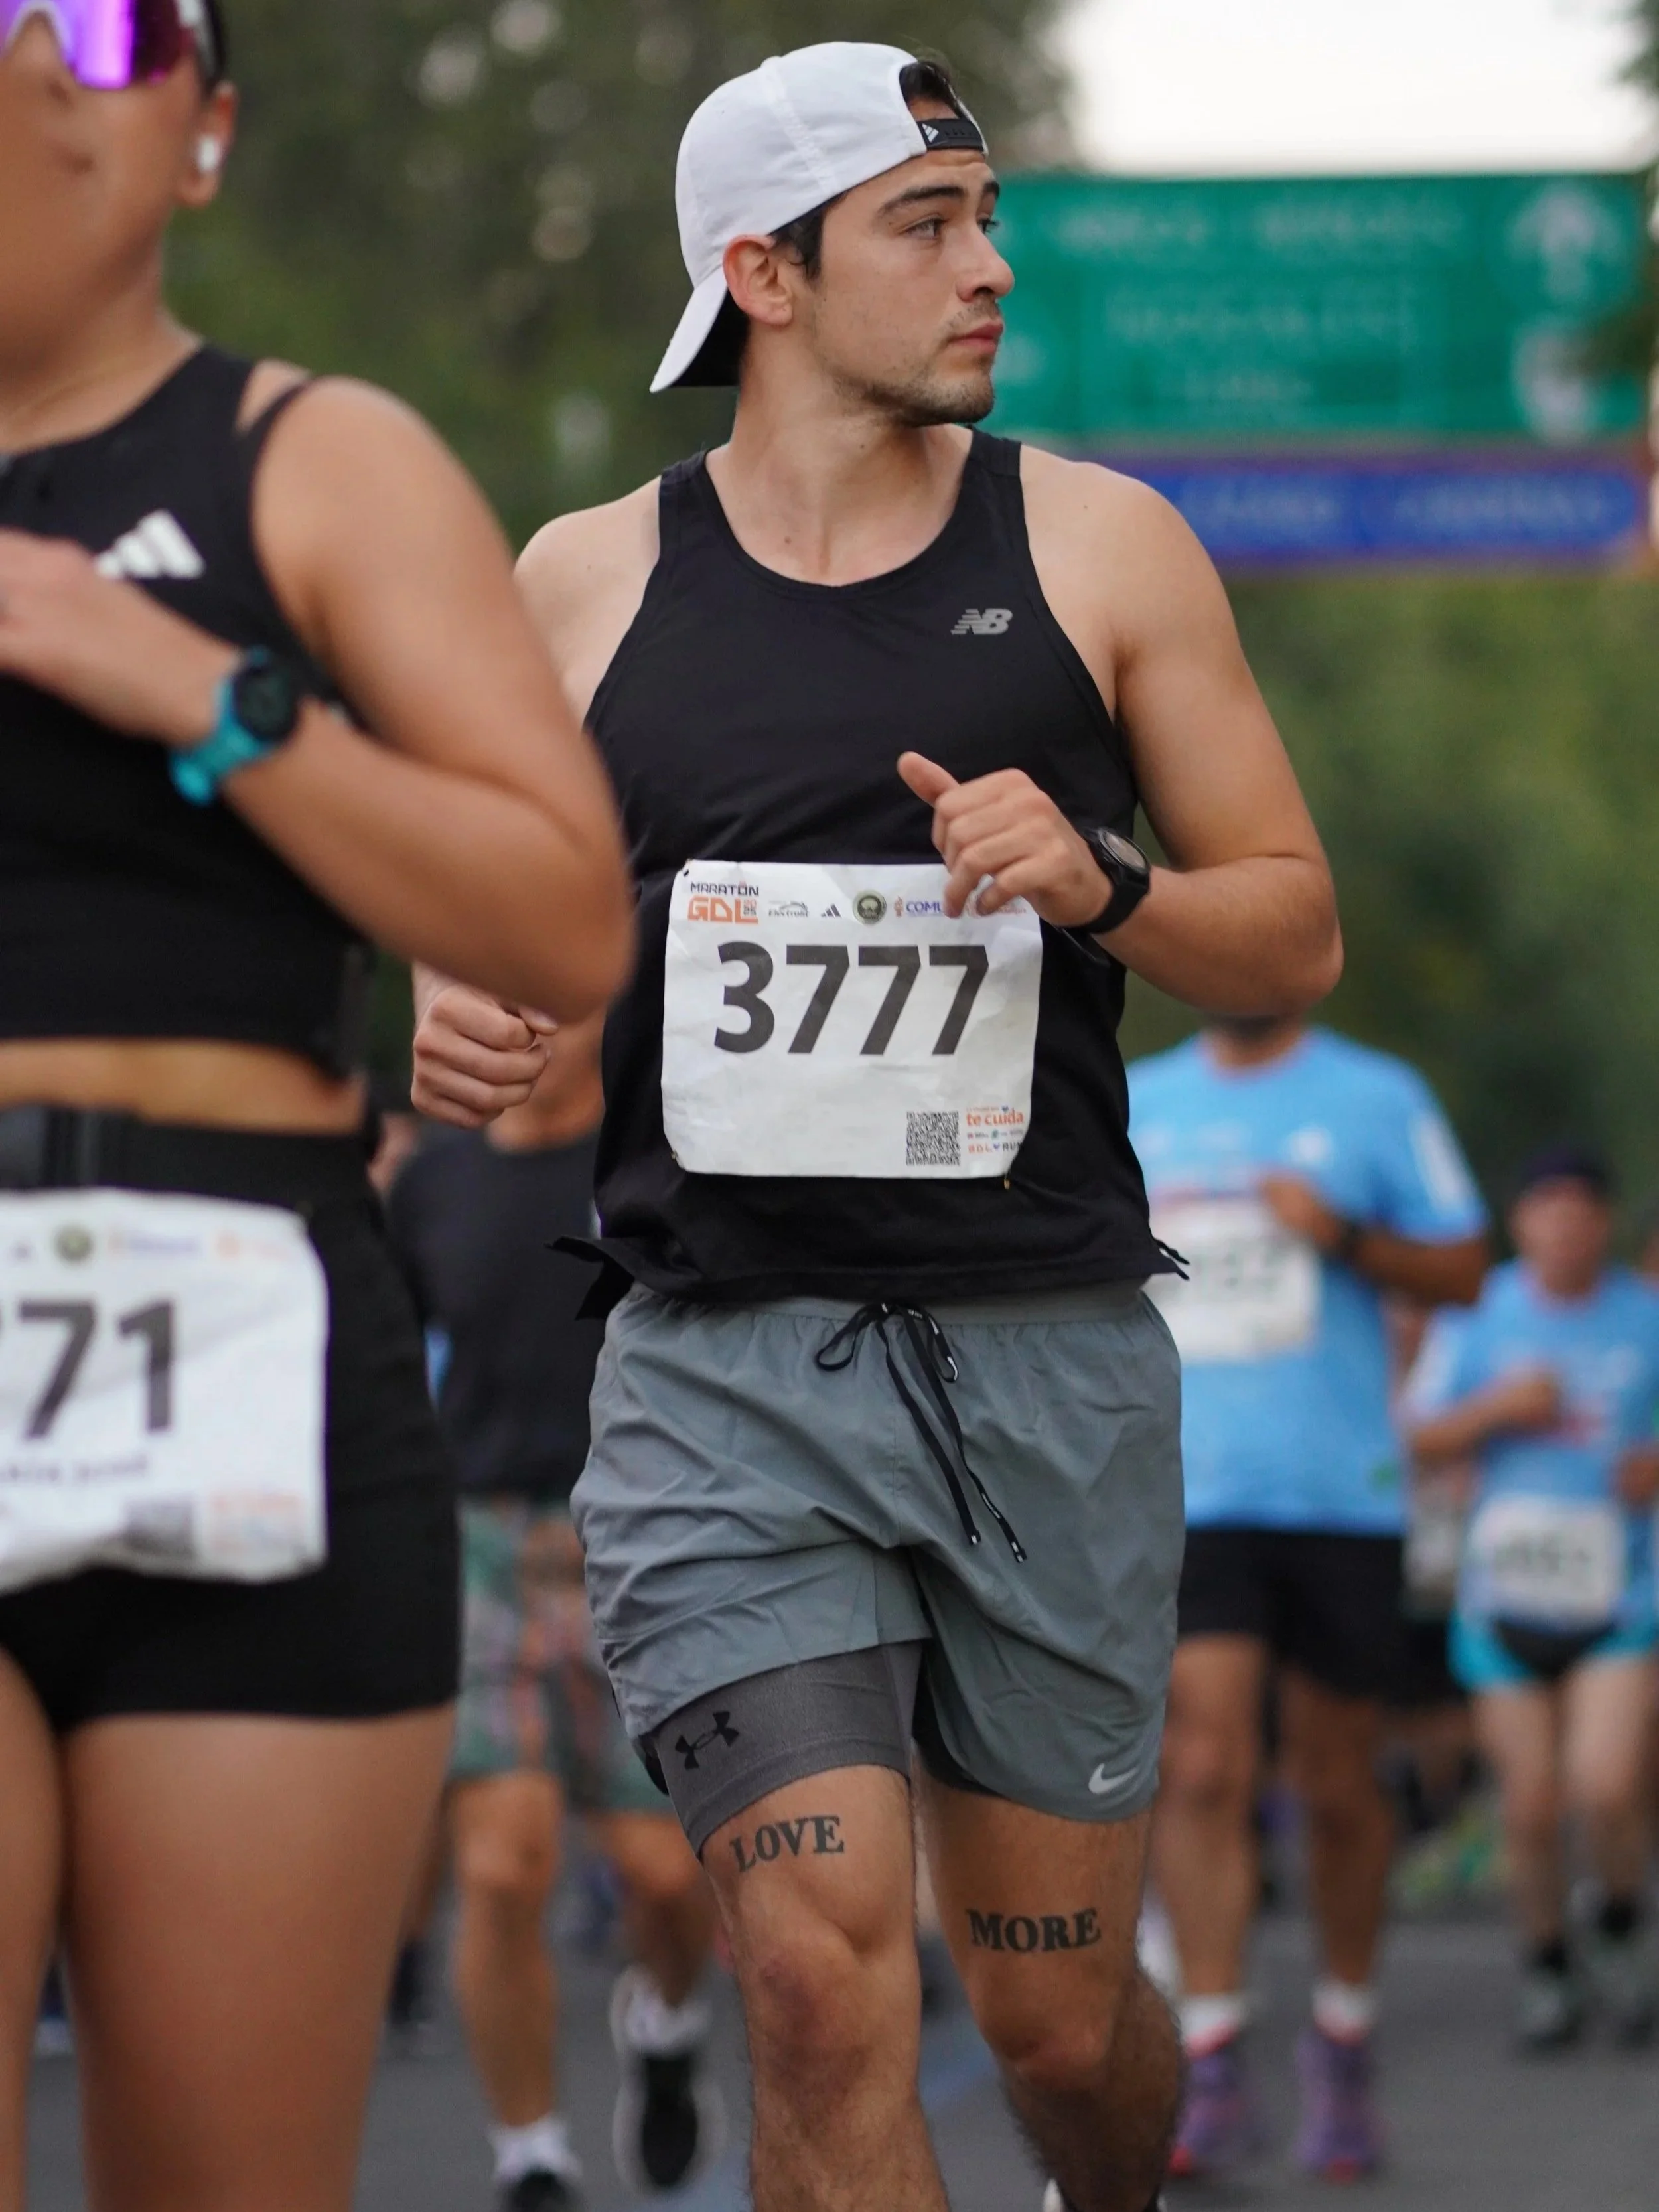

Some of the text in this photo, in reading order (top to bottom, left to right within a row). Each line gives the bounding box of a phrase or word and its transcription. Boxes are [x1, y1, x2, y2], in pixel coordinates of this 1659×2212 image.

[687, 896, 758, 924] GDL
[714, 940, 989, 1055] 3777
[967, 1108, 1023, 1126] te cuida
[0, 1299, 175, 1439] 71
[729, 1814, 844, 1873] LOVE
[966, 1906, 1102, 1952] MORE
